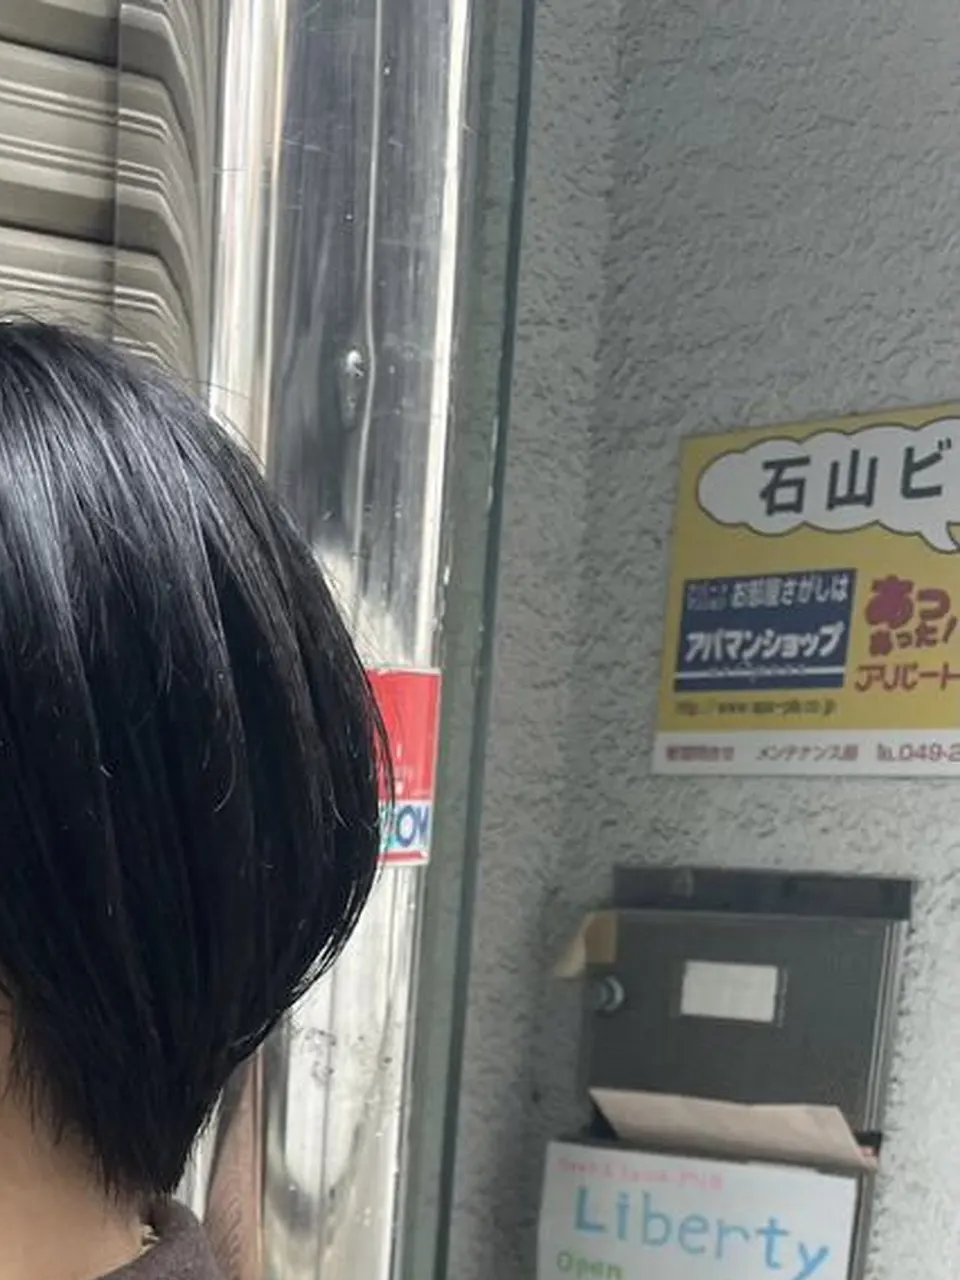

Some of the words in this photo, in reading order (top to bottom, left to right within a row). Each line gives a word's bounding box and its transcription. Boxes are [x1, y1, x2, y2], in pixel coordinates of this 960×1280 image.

[684, 620, 845, 663] アパマンショップ
[556, 1251, 623, 1280] Open
